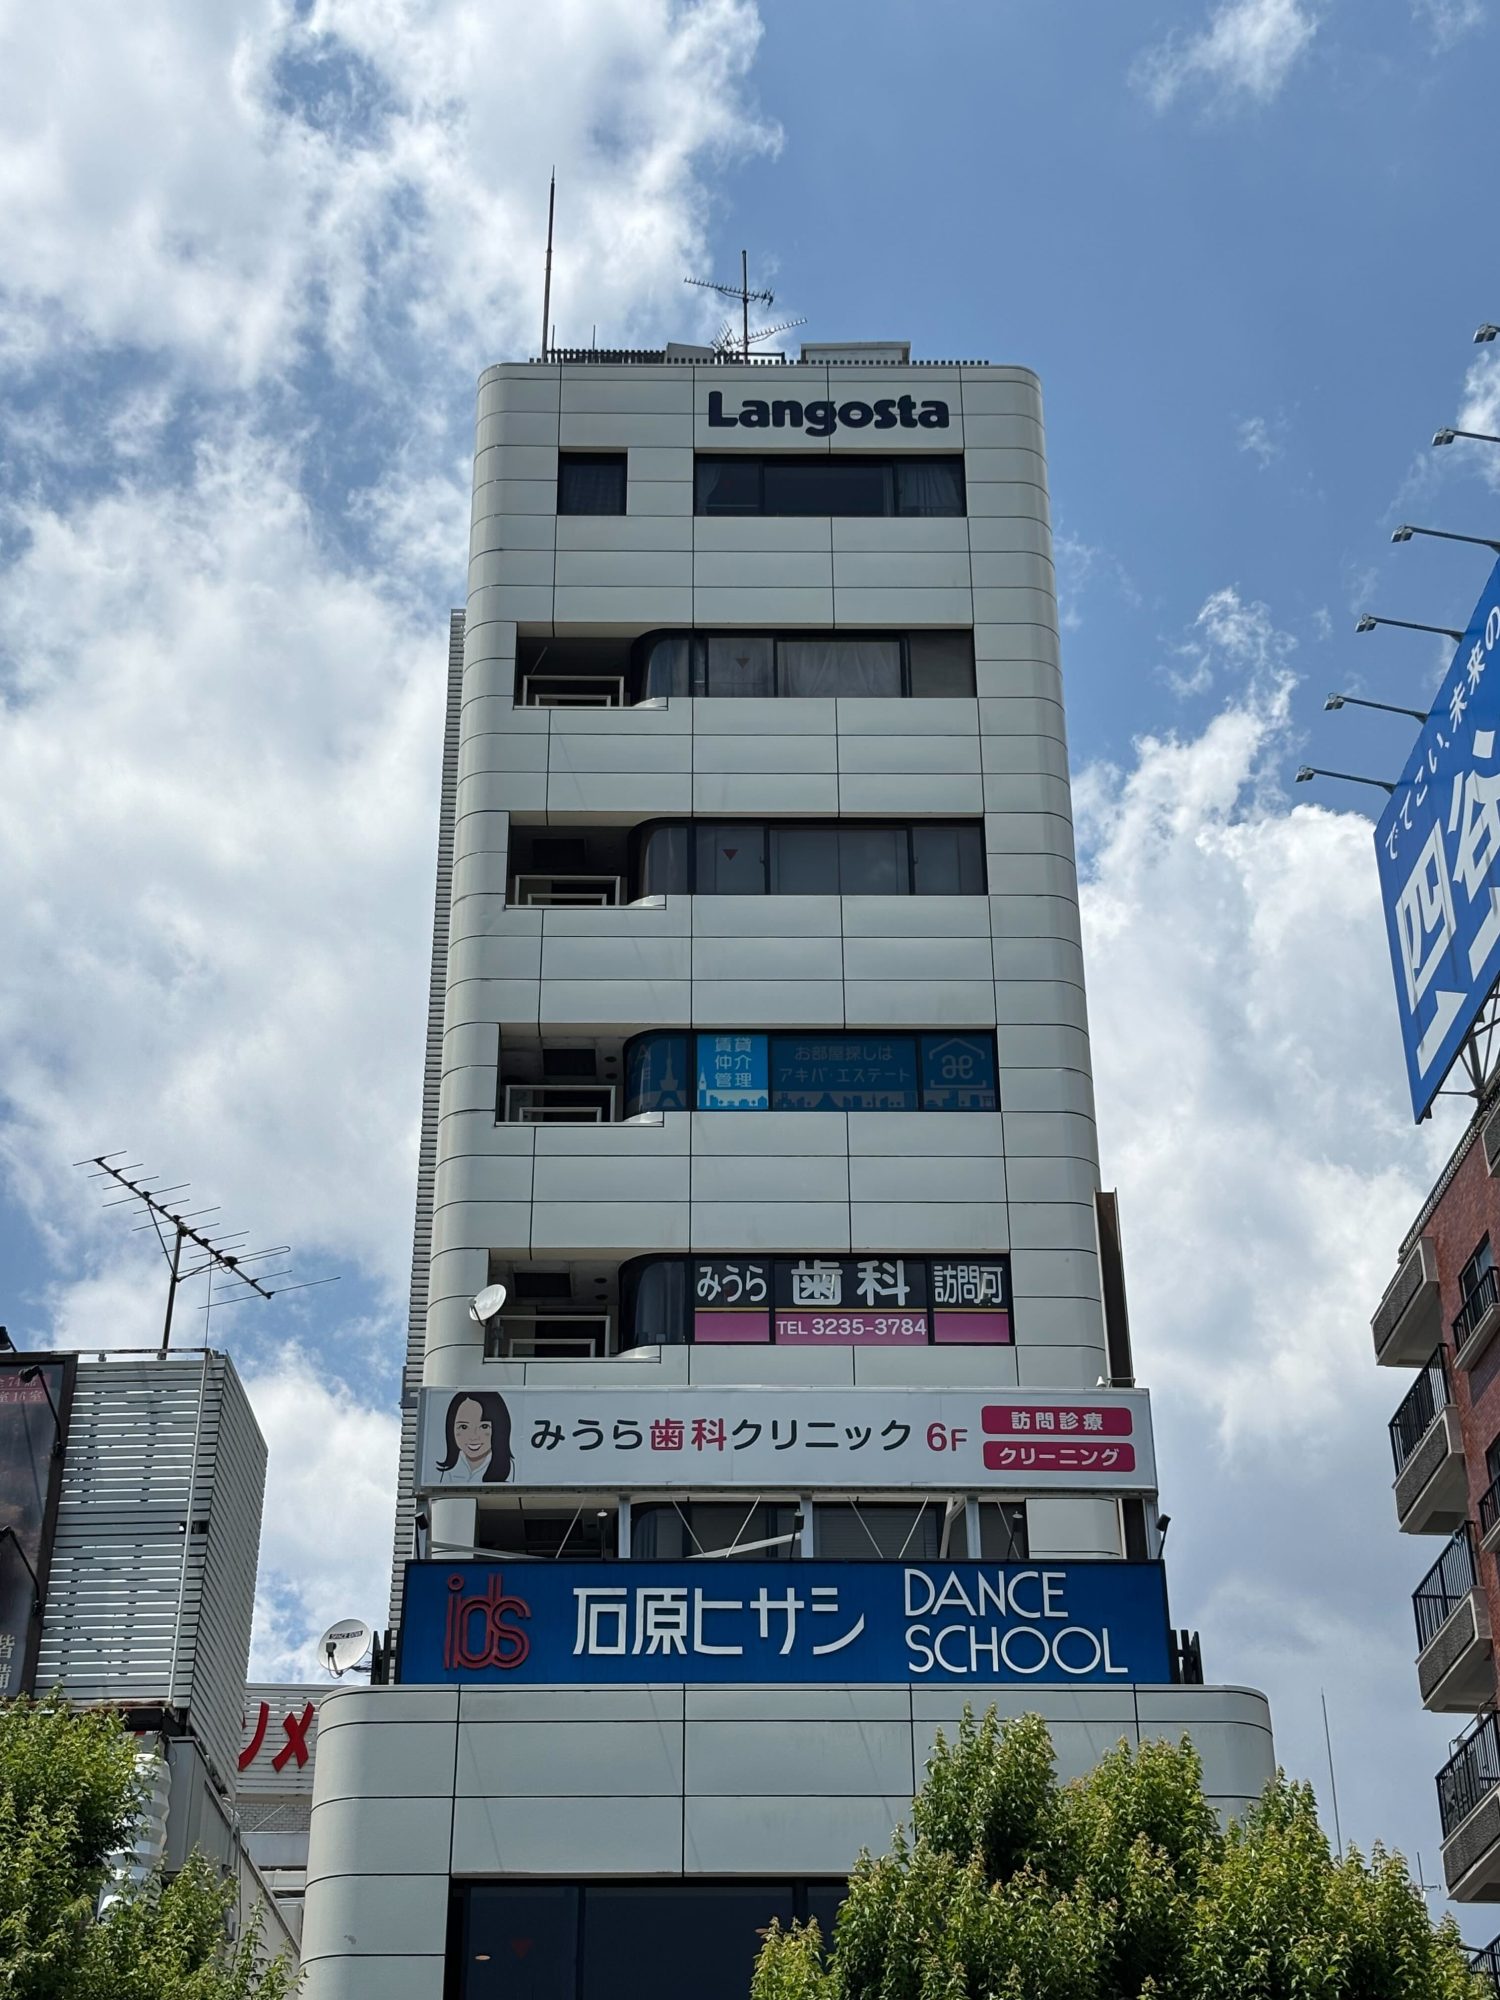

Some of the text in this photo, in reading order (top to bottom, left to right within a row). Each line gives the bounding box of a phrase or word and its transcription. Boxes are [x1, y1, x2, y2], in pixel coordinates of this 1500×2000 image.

[708, 391, 950, 437] Langosta
[1394, 729, 1500, 1016] 四谷
[715, 1054, 752, 1070] 仲介
[794, 1045, 893, 1061] お部屋探しは
[715, 1072, 752, 1088] 管理
[697, 1259, 1003, 1306] みうら 歯科 訪問可
[776, 1318, 927, 1335] TEL 3235-3784
[530, 1418, 968, 1452] みうら歯科クリニック 6F
[1011, 1411, 1104, 1431] 訪問診療
[1000, 1446, 1120, 1467] クリーニング
[904, 1568, 1069, 1619] DANCE
[572, 1587, 865, 1655] 石原ヒサシ
[905, 1624, 1129, 1674] SCHOOL
